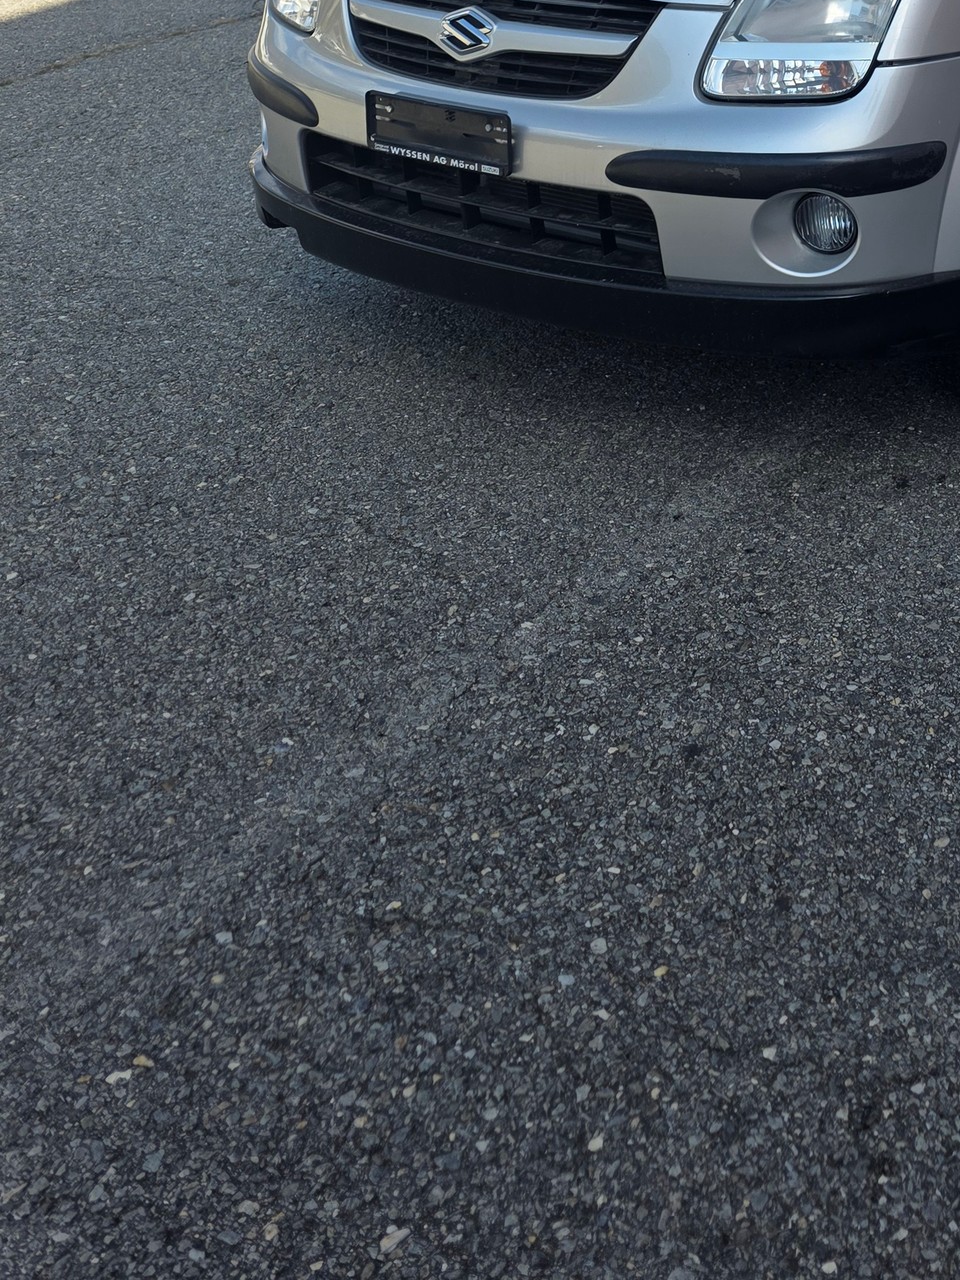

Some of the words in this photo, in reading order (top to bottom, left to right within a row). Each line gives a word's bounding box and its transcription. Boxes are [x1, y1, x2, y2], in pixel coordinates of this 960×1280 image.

[390, 146, 430, 162] WYSSEN
[432, 155, 447, 165] AG
[449, 158, 478, 172] Mörel
